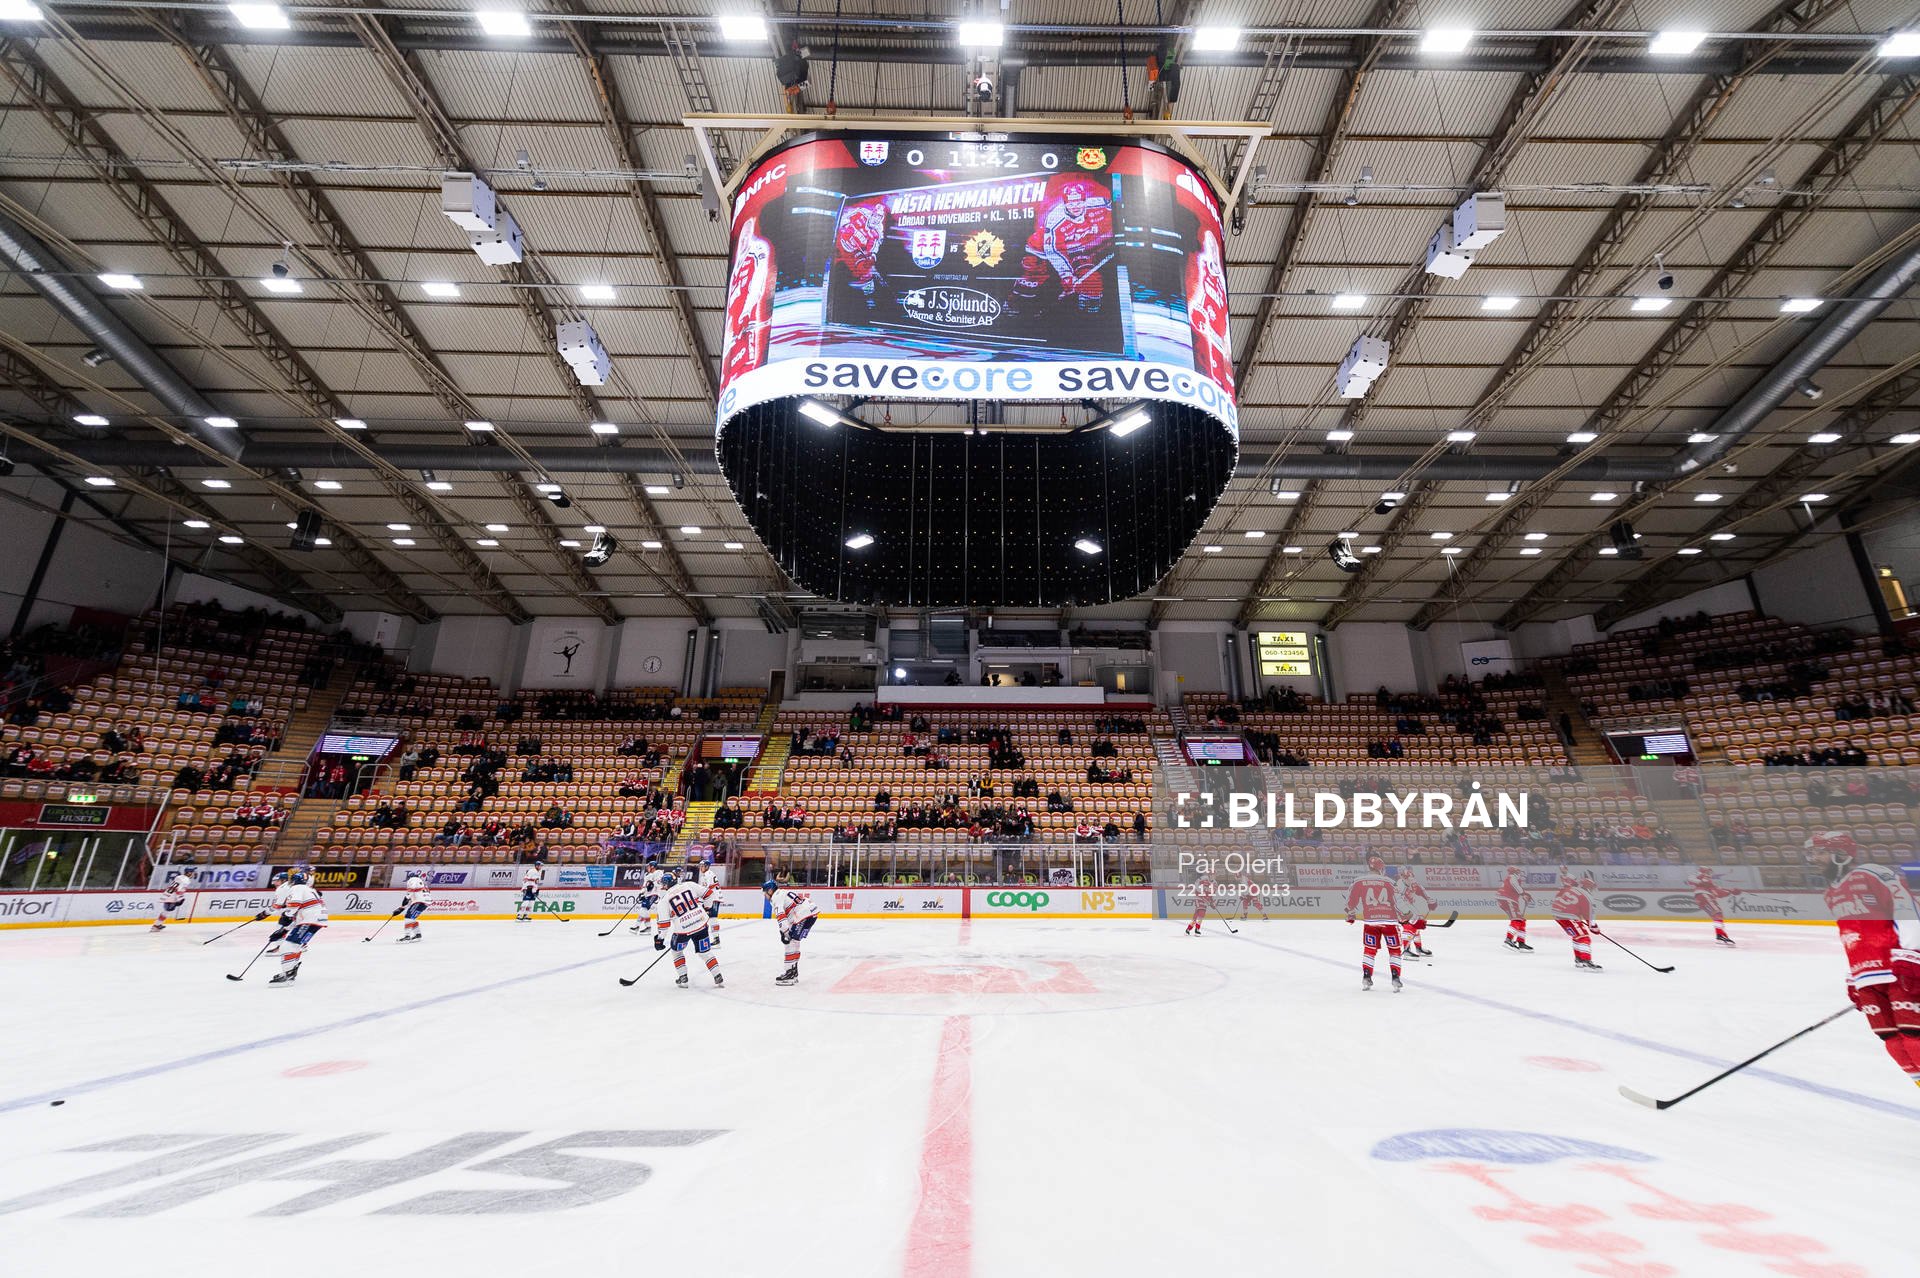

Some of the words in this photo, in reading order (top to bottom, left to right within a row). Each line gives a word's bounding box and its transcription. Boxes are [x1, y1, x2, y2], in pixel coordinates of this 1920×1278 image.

[906, 149, 924, 166] 0
[1041, 152, 1059, 169] 0
[891, 191, 931, 214] NÄSTA
[934, 181, 1047, 210] HEMMAMATCH
[898, 214, 925, 226] LÖRDAG
[927, 214, 936, 225] 19
[937, 212, 981, 224] NOVEMBER
[990, 210, 1005, 222] KL.
[928, 291, 997, 318] J.Sjölunds
[907, 308, 935, 322] Värme
[936, 312, 943, 322] &
[945, 311, 976, 325] Sanitet
[978, 316, 992, 326] AB
[804, 361, 1033, 392] savecore
[1058, 364, 1237, 429] savecore
[60, 815, 92, 823] HUSET
[165, 867, 258, 884] Rnnes
[313, 871, 358, 883] RLUND
[491, 871, 512, 879] MM
[1299, 868, 1332, 876] BUCHER
[1425, 867, 1480, 876] PIZZERIA
[127, 901, 155, 910] SCA
[209, 898, 273, 910] RENEW
[345, 893, 373, 911] Diös
[669, 889, 699, 918] 60
[987, 891, 1050, 912] coop
[1081, 891, 1116, 911] NP3
[1365, 887, 1391, 907] 44
[1438, 898, 1498, 908] andelsbanke
[514, 900, 576, 913] TRAB
